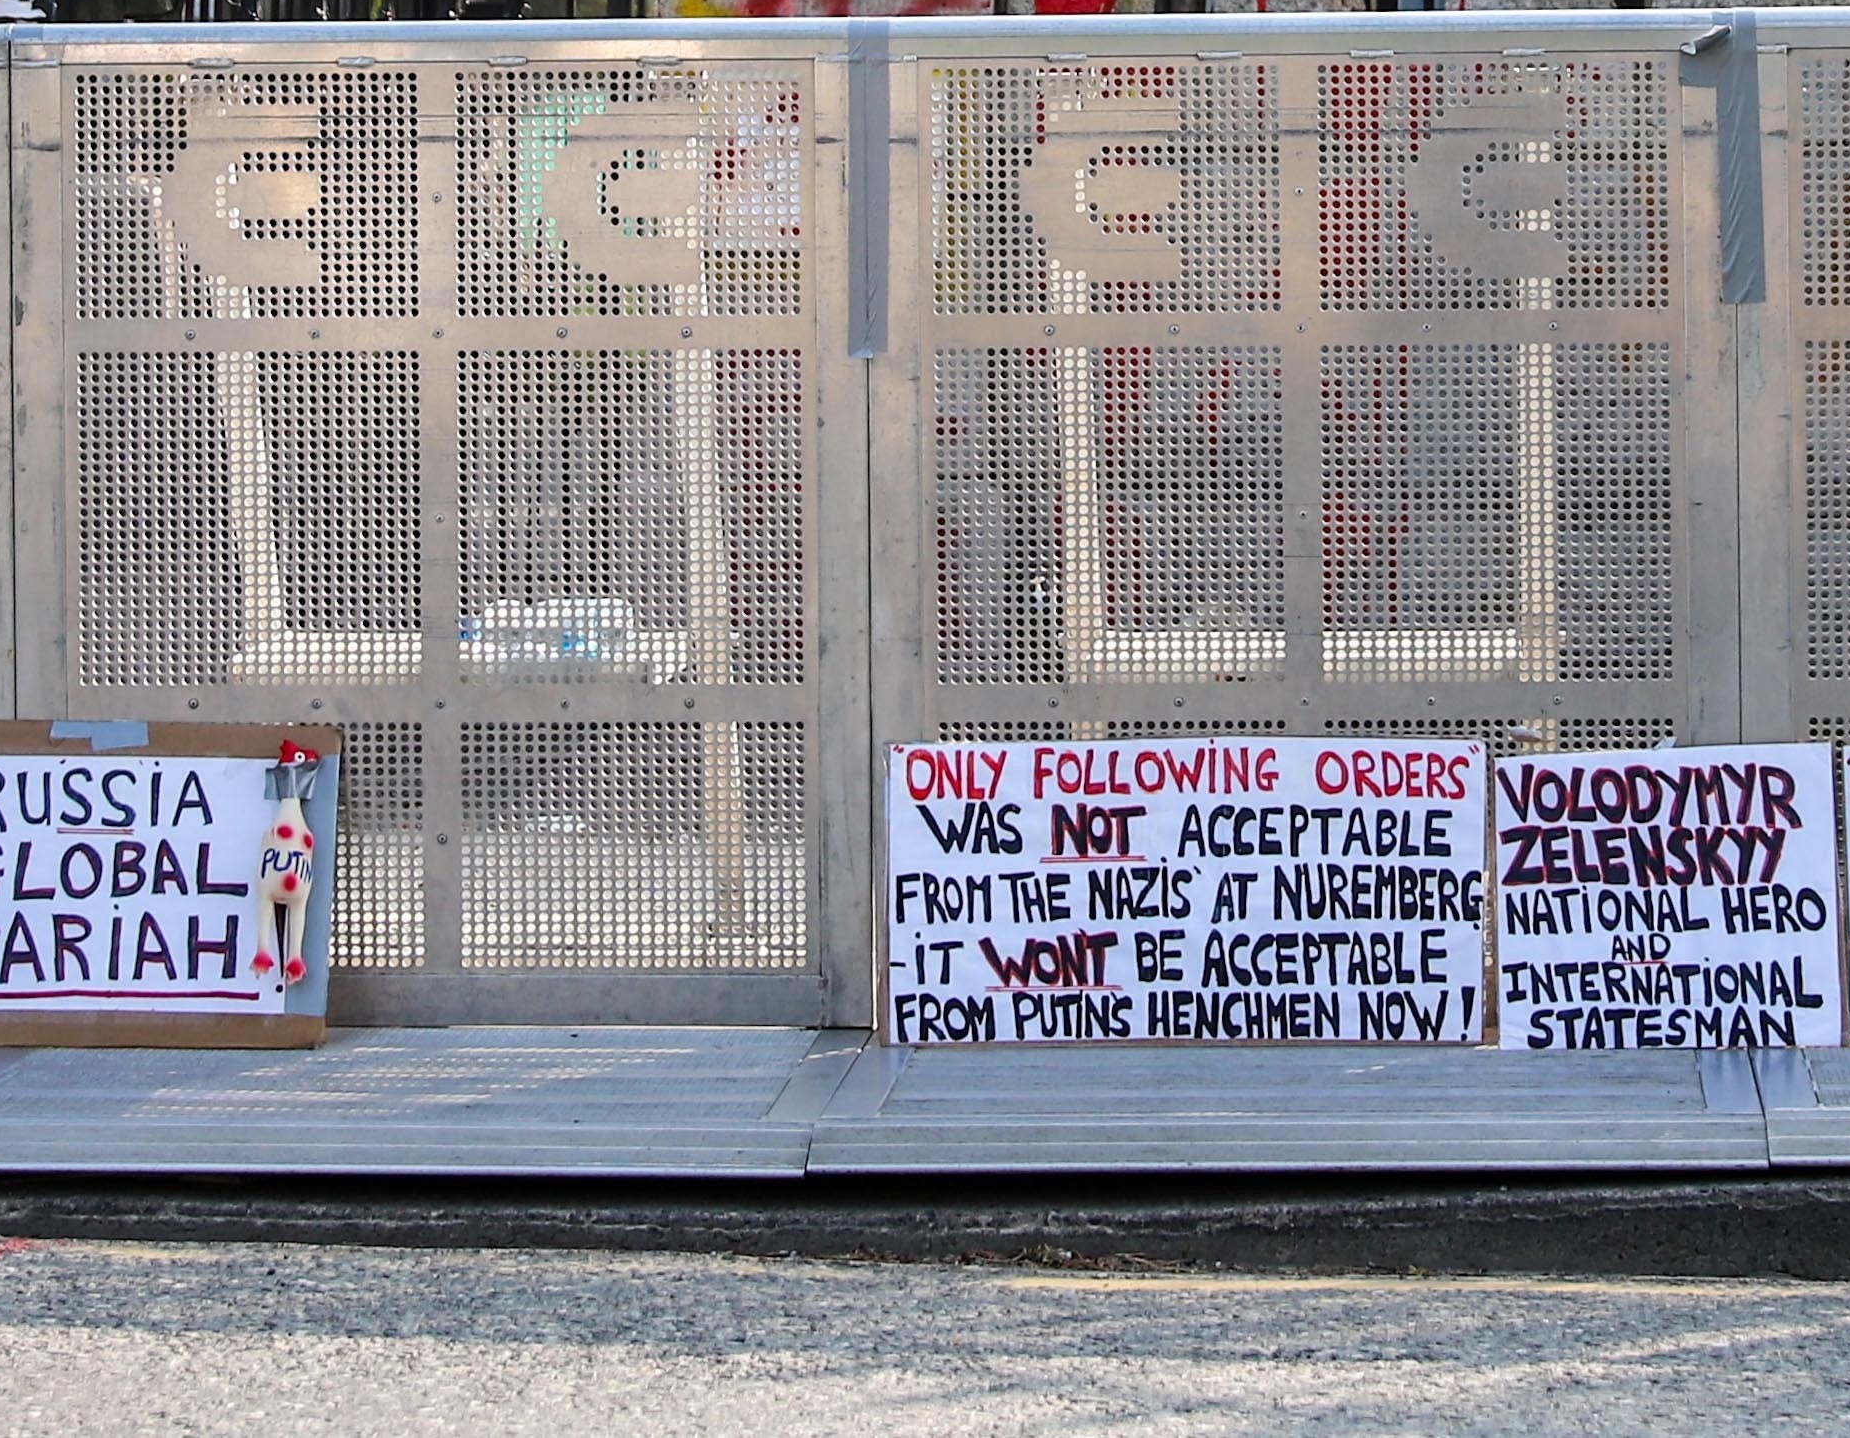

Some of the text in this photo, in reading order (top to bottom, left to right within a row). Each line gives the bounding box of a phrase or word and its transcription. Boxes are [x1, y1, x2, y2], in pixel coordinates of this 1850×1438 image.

[1034, 740, 1279, 798] FOLLOWING
[1495, 764, 1802, 827] VOLODYMYR
[916, 802, 1453, 856] WAS NOT ACCEPTABLE
[261, 848, 311, 884] PUTIN
[1500, 826, 1786, 887] ZELENSKYY
[896, 873, 991, 923] FROM
[999, 872, 1071, 920] THE
[1211, 872, 1261, 923] AT
[1506, 885, 1709, 933] NATIONAL
[1721, 888, 1826, 932] HERO
[1135, 931, 1187, 981] BE
[1202, 929, 1448, 986] ACCEPTABLE
[1611, 933, 1670, 960] AND
[1503, 957, 1823, 1007] INTERNATIONAL
[896, 992, 996, 1042] FROM
[1149, 991, 1339, 1038] HENCHMEN
[1528, 1008, 1796, 1048] STATESMAN
